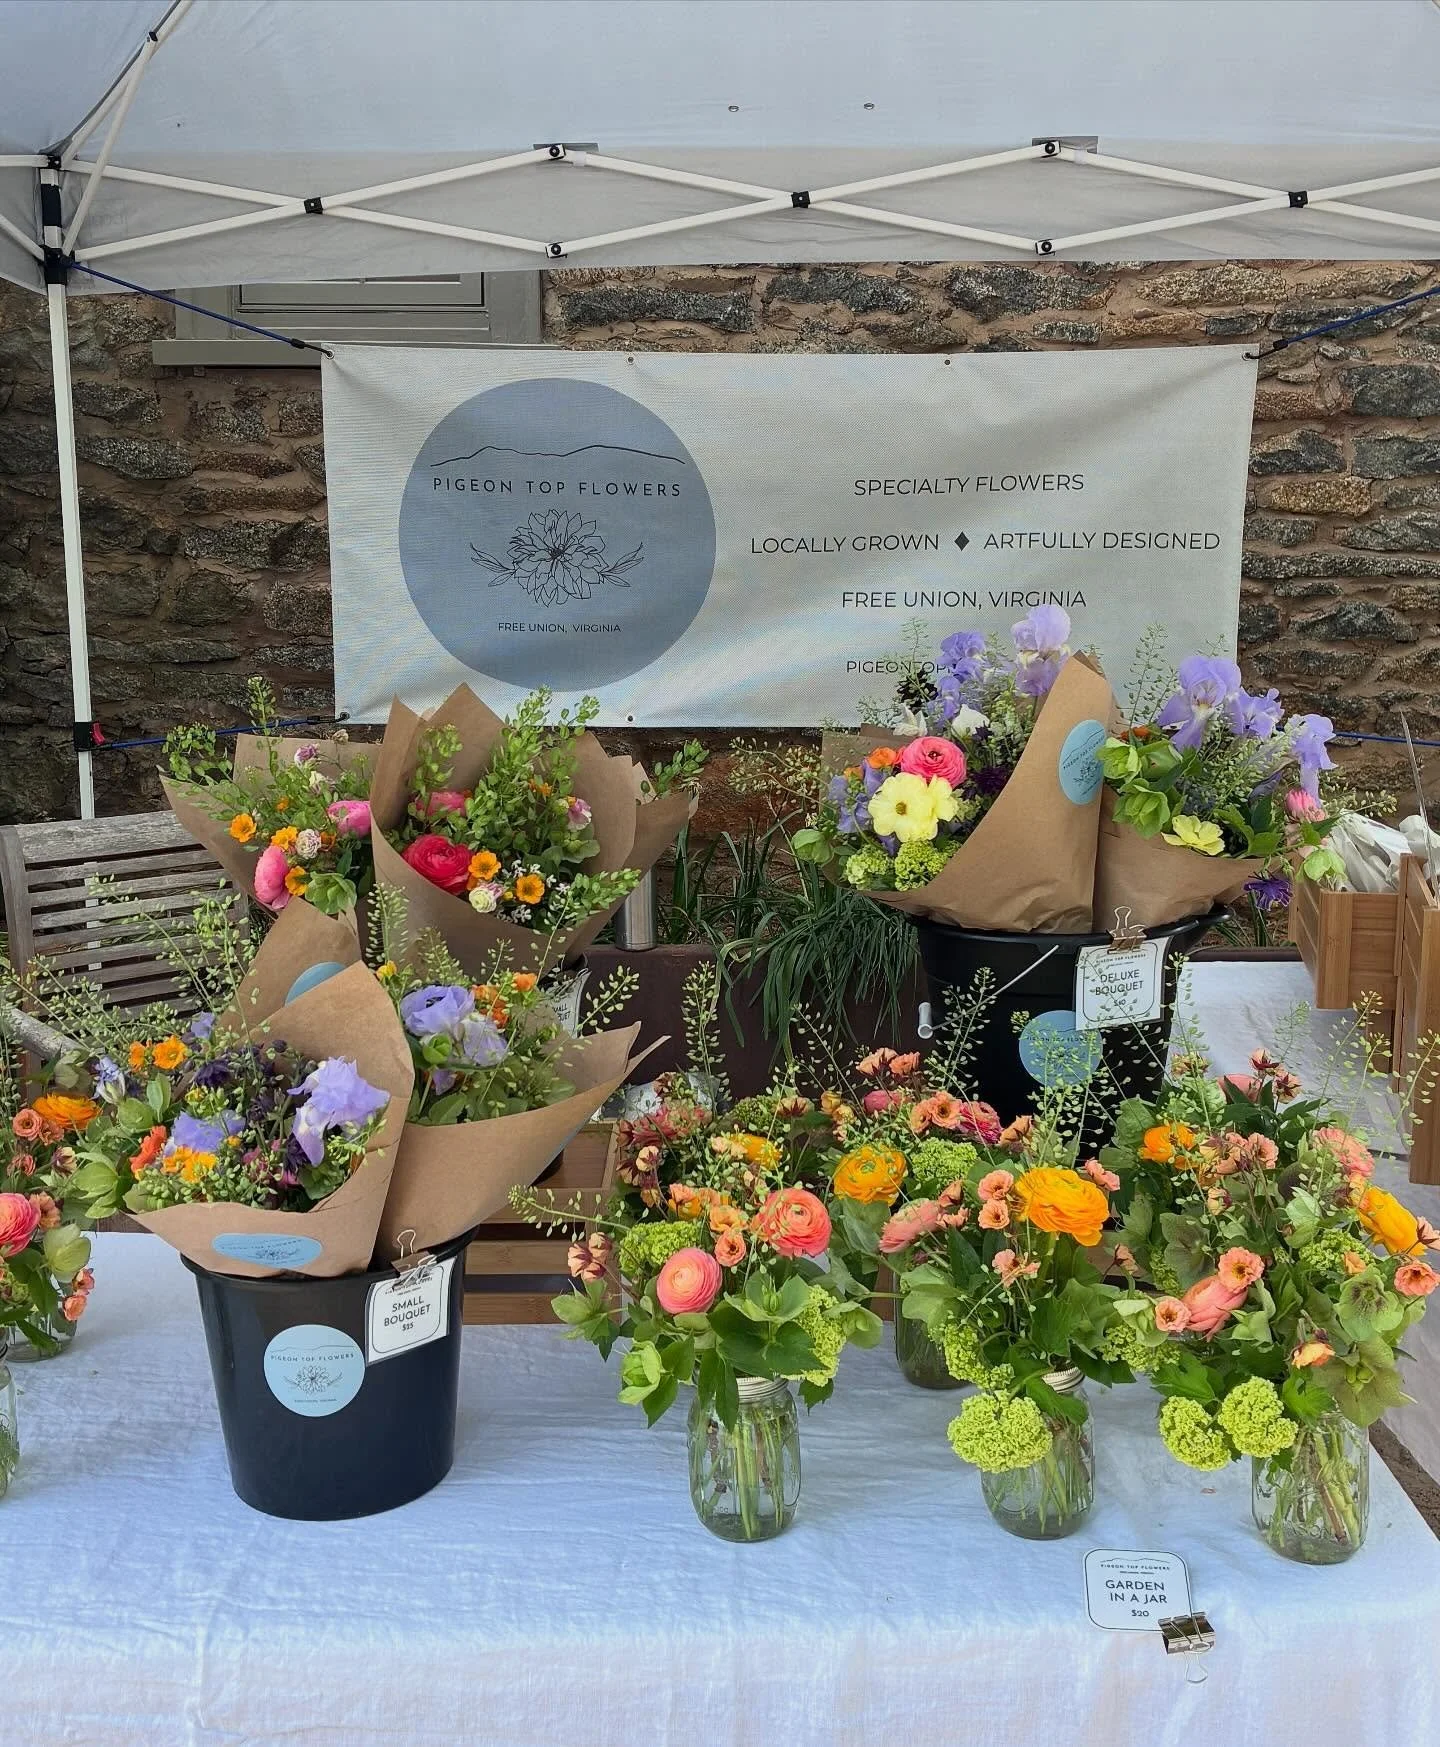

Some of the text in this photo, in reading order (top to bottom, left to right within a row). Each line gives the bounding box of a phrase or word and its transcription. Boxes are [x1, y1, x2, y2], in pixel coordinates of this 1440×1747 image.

[432, 476, 682, 497] PIGEON TOP FLOWERS
[853, 473, 1085, 497] SPECIALTY FLOWERS
[750, 531, 1221, 554] LOCALLY GROWN ARTFULLY DESIGNED
[842, 590, 1087, 611] FREE UNION, VIRGINIA
[497, 622, 621, 635] FREE UNION, VIRGINIA
[1100, 969, 1140, 983] DELUXE
[1095, 980, 1144, 996] BOUQUET
[392, 1295, 425, 1313] SMALL
[384, 1304, 431, 1327] BOUQUET
[270, 1354, 298, 1362] PIGEON
[318, 1353, 355, 1361] FLOWERS
[1105, 1579, 1165, 1591] GARDEN
[1110, 1592, 1168, 1604] IN A JAR
[1131, 1609, 1150, 1617] $20
